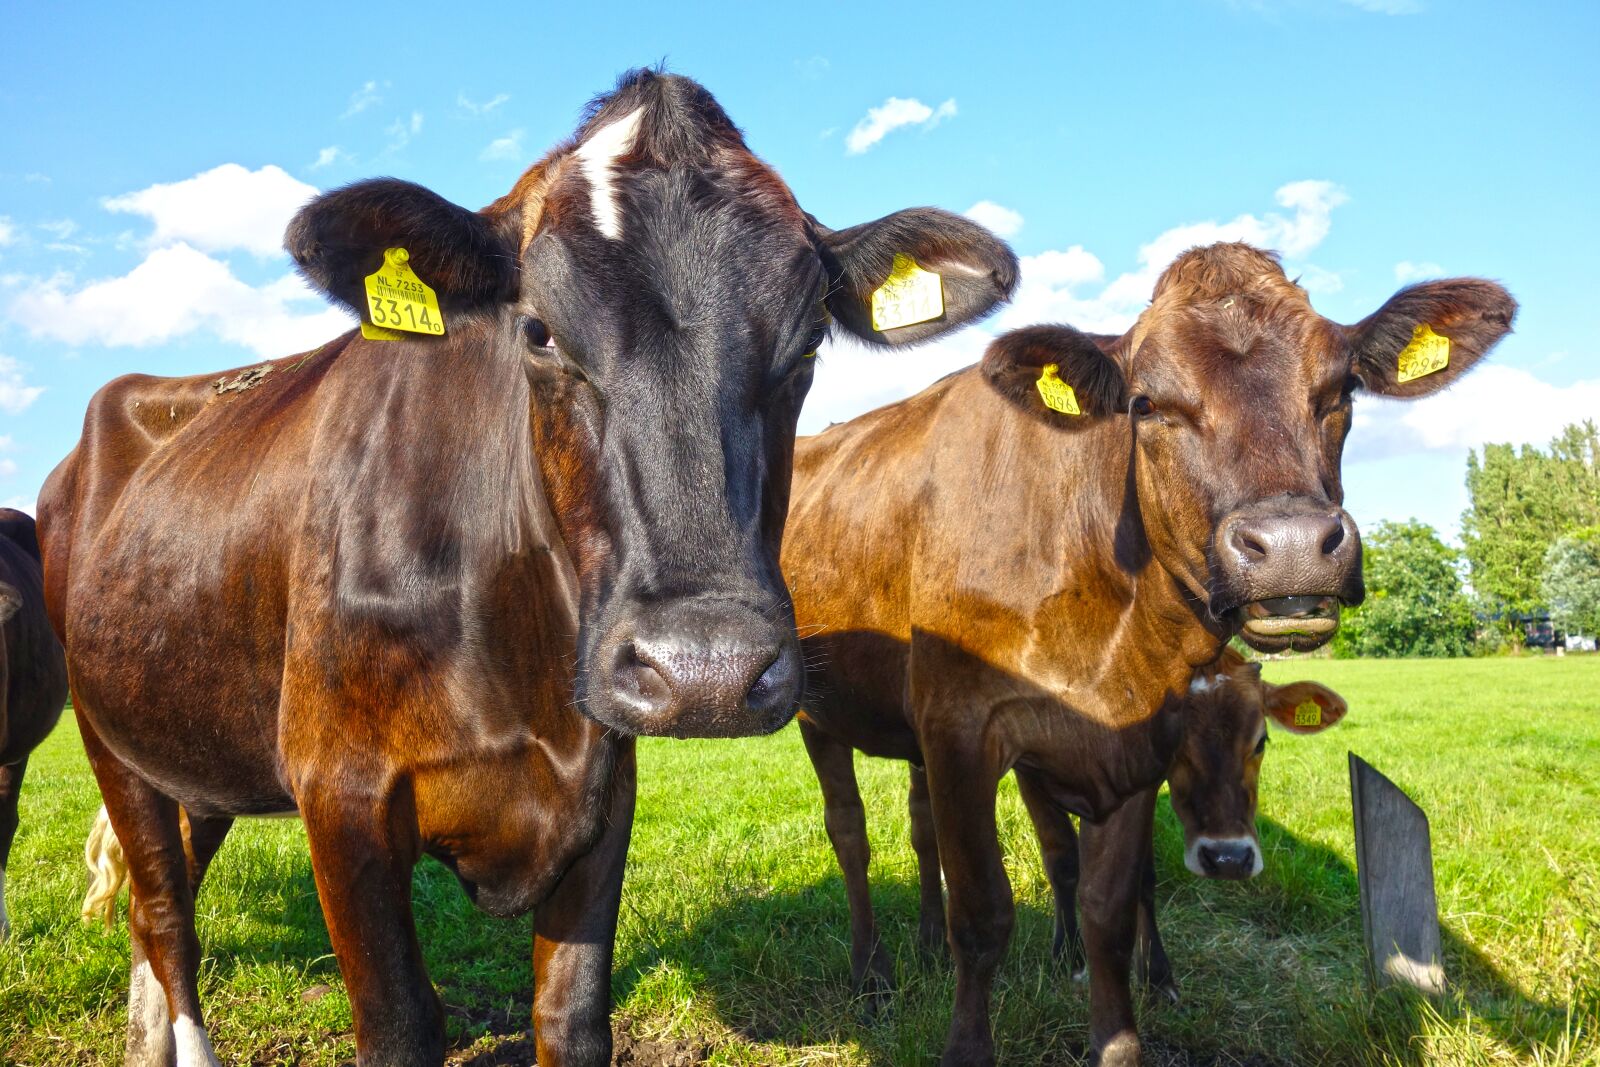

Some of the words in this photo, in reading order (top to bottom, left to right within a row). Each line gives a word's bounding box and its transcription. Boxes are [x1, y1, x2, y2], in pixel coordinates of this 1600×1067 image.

[377, 275, 391, 287] NL
[397, 279, 424, 293] 7253
[1295, 714, 1317, 725] 3349
